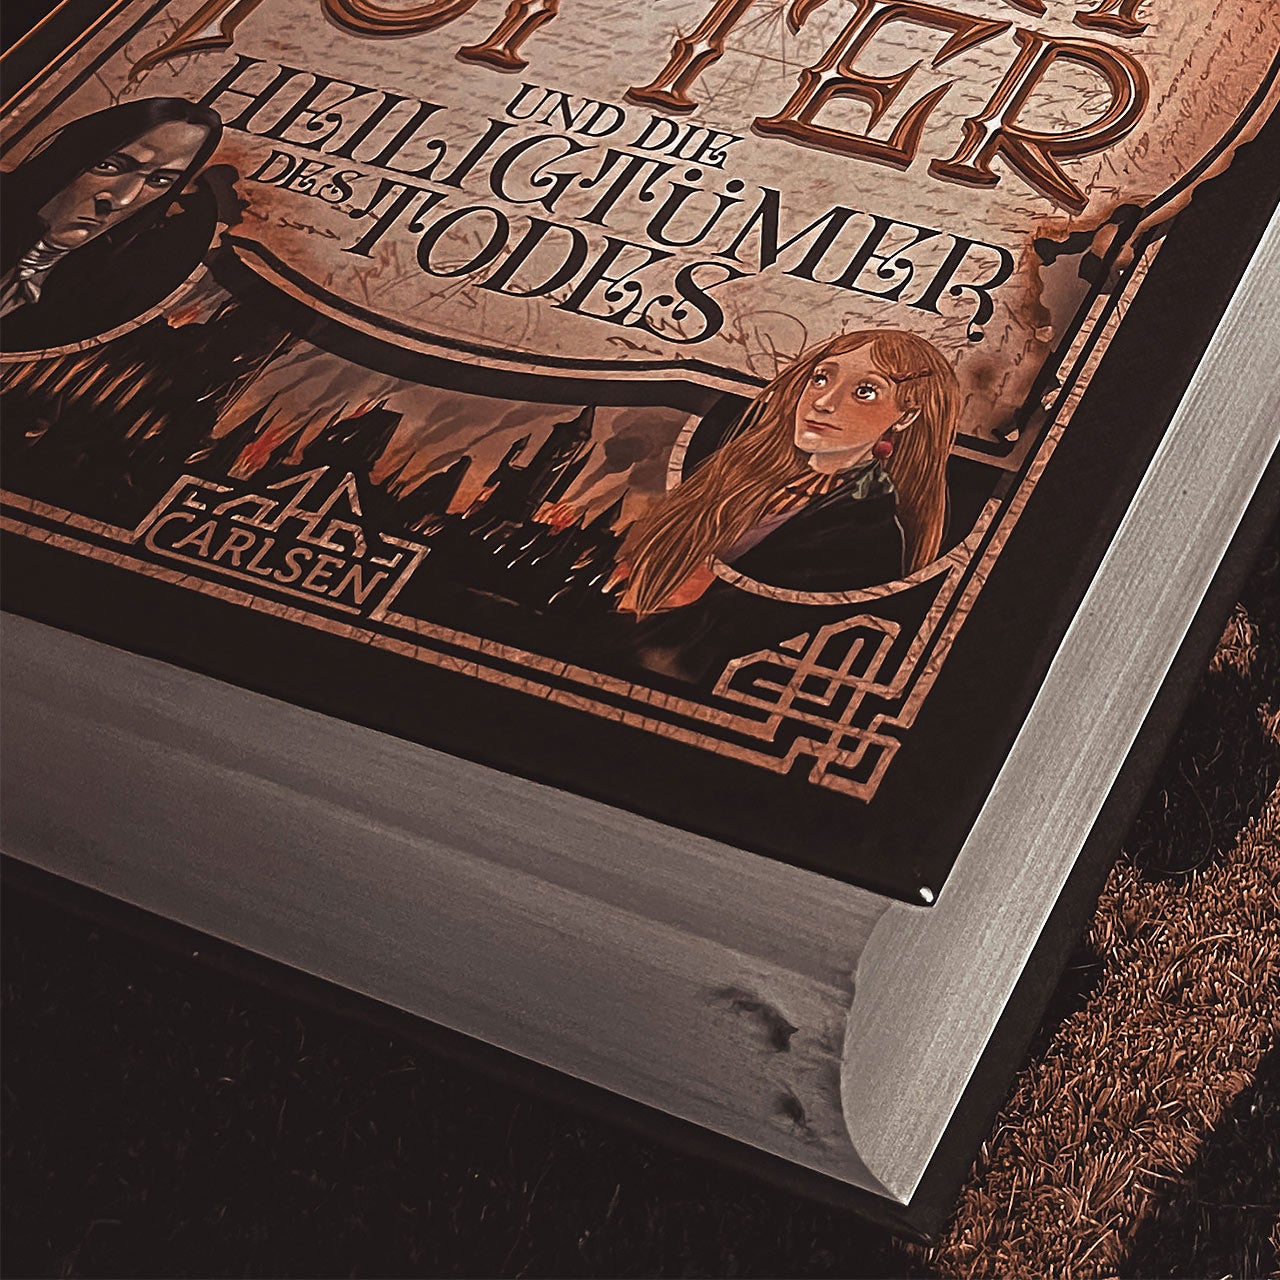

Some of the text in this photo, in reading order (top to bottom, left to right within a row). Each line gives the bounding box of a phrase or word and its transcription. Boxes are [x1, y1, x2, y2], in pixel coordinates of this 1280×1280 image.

[203, 56, 1015, 342] HEILIGTÜMER
[505, 82, 745, 170] UND DIE
[246, 148, 765, 346] DES TODES
[144, 510, 389, 606] CARLSEN
